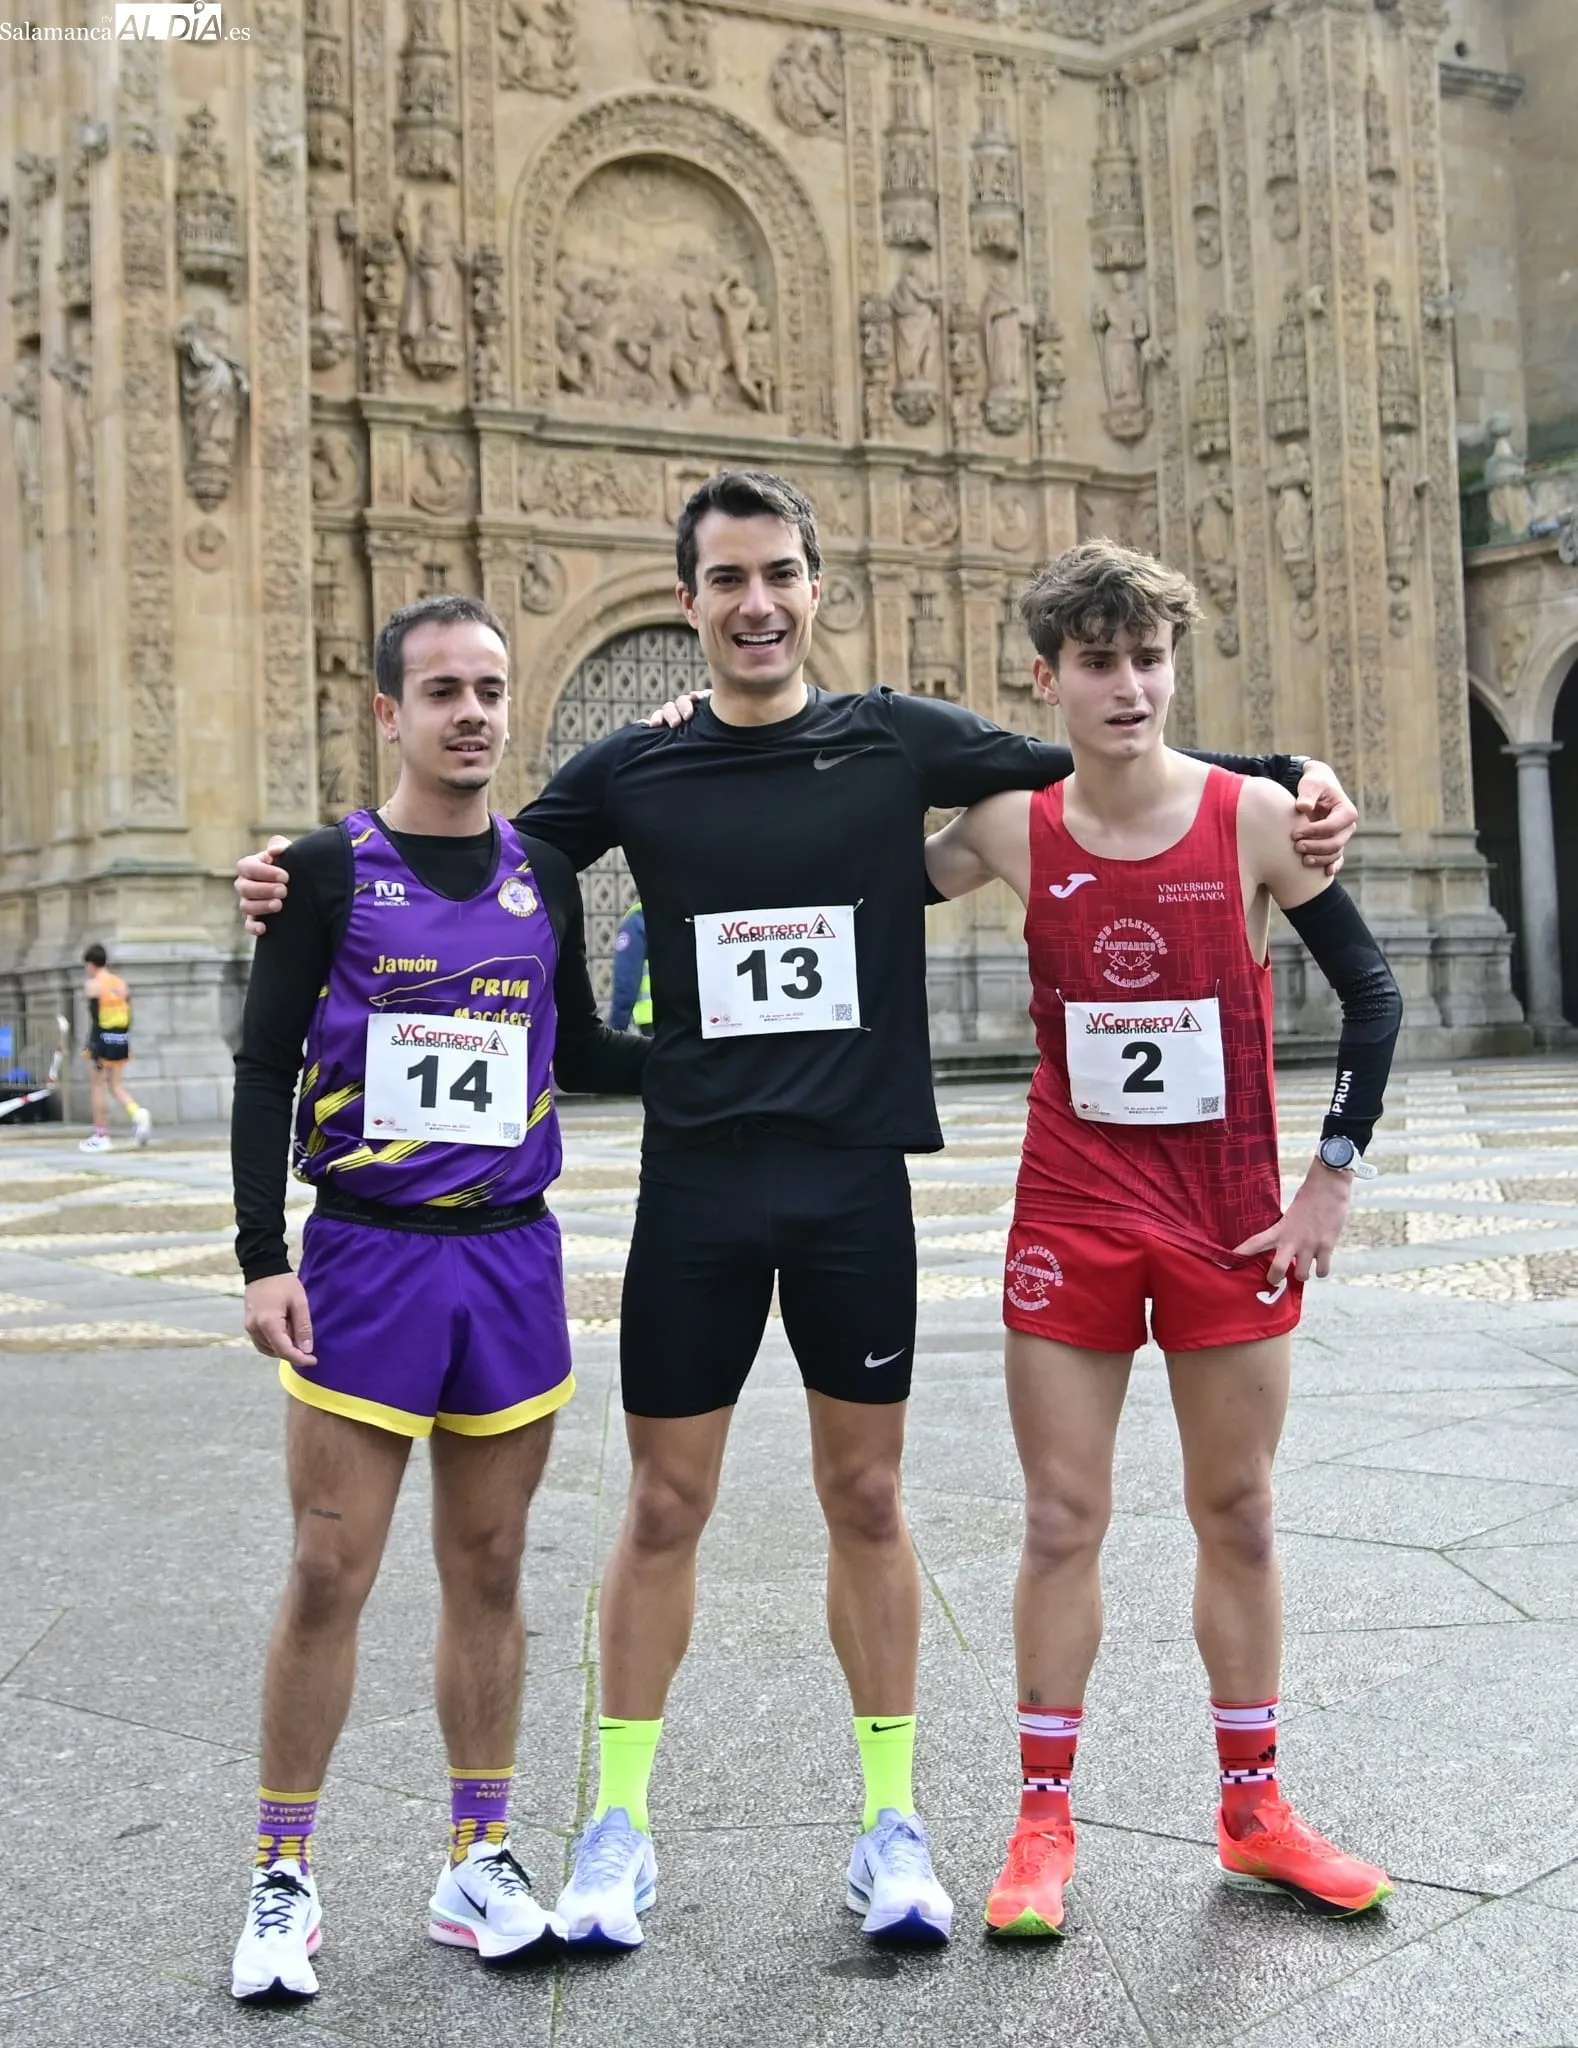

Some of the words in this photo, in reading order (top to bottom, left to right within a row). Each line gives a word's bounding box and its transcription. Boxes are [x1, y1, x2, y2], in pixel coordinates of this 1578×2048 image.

[1158, 881, 1224, 893] VNIVERSIDAD
[1166, 891, 1225, 902] SALAMANCA
[372, 954, 438, 975] Jamón
[736, 947, 823, 1002] 13
[470, 977, 530, 999] PRIM
[1121, 1041, 1164, 1093] 2
[407, 1055, 493, 1113] 14
